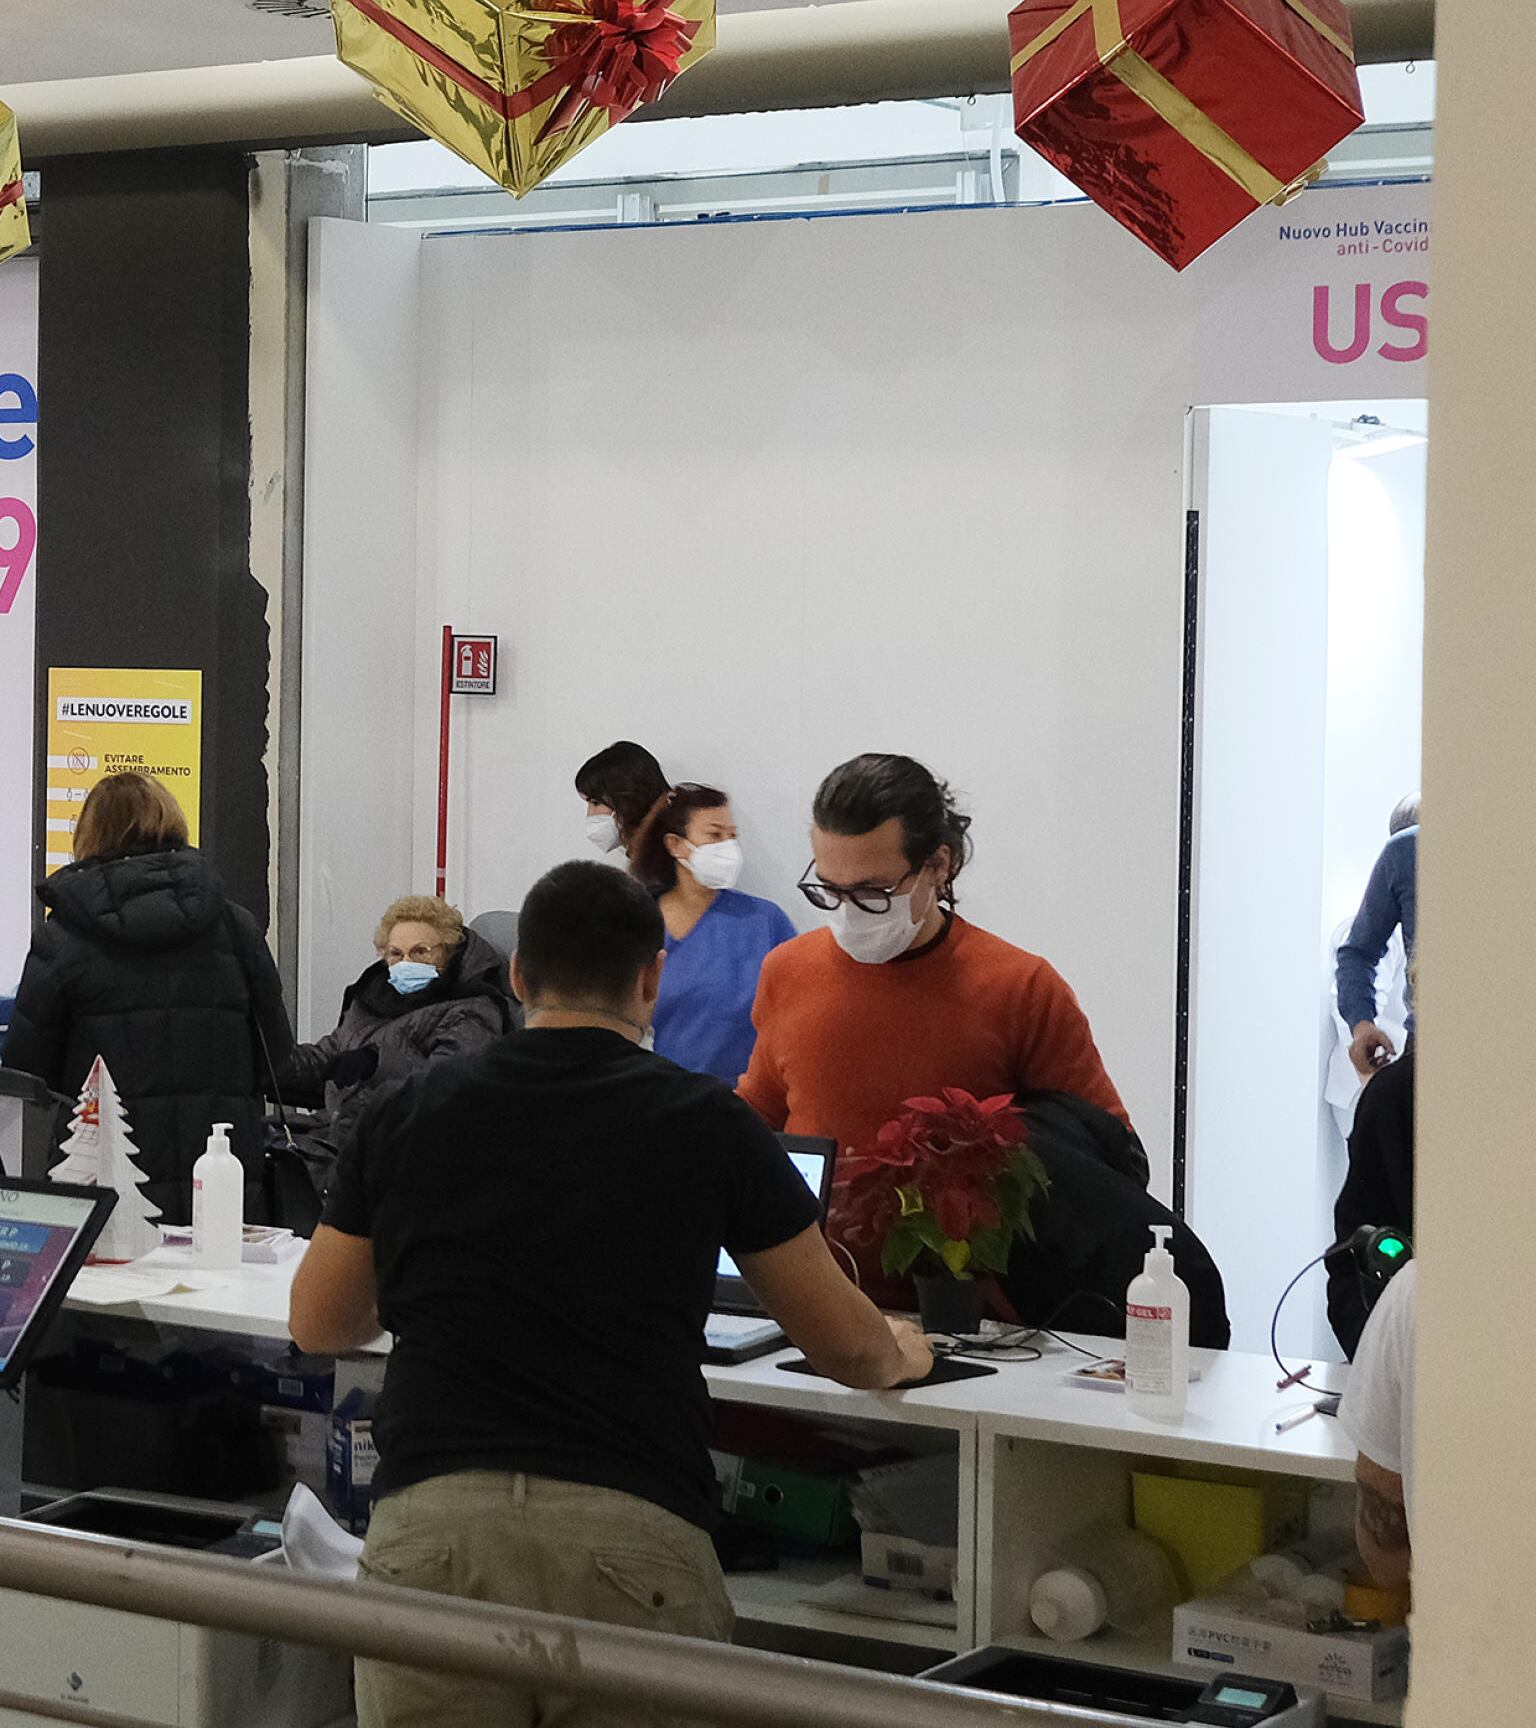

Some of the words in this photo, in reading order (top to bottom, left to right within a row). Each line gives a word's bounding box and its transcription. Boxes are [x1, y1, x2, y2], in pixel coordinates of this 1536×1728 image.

[1279, 225, 1331, 240] Nuovo
[1336, 221, 1369, 238] Hub
[1374, 219, 1428, 235] Vaccin
[1313, 280, 1429, 364] US
[61, 703, 188, 719] #LENUOVEREGOLE
[104, 754, 145, 764] EVITARE
[1, 1258, 12, 1270] P
